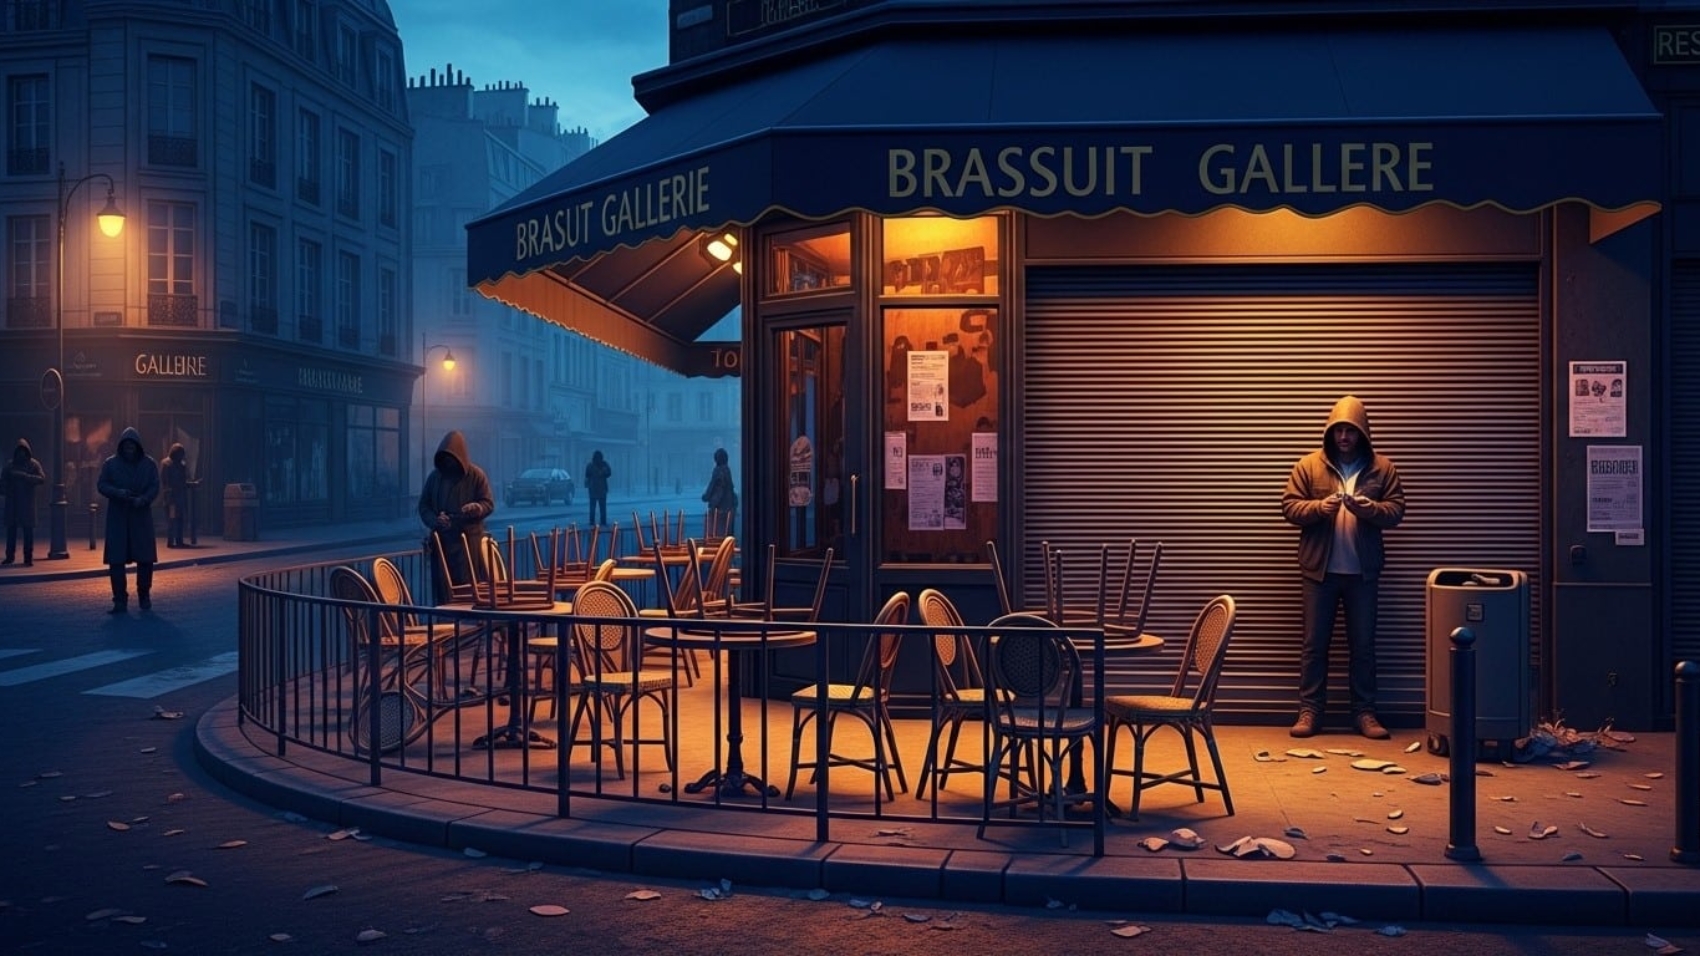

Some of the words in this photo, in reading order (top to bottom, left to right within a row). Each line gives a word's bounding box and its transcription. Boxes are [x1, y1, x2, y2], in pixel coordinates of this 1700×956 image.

[889, 146, 1153, 198] BRASSUIT
[1198, 142, 1434, 194] GALLERE
[516, 201, 593, 261] BRASUT
[602, 166, 710, 236] GALLERIE
